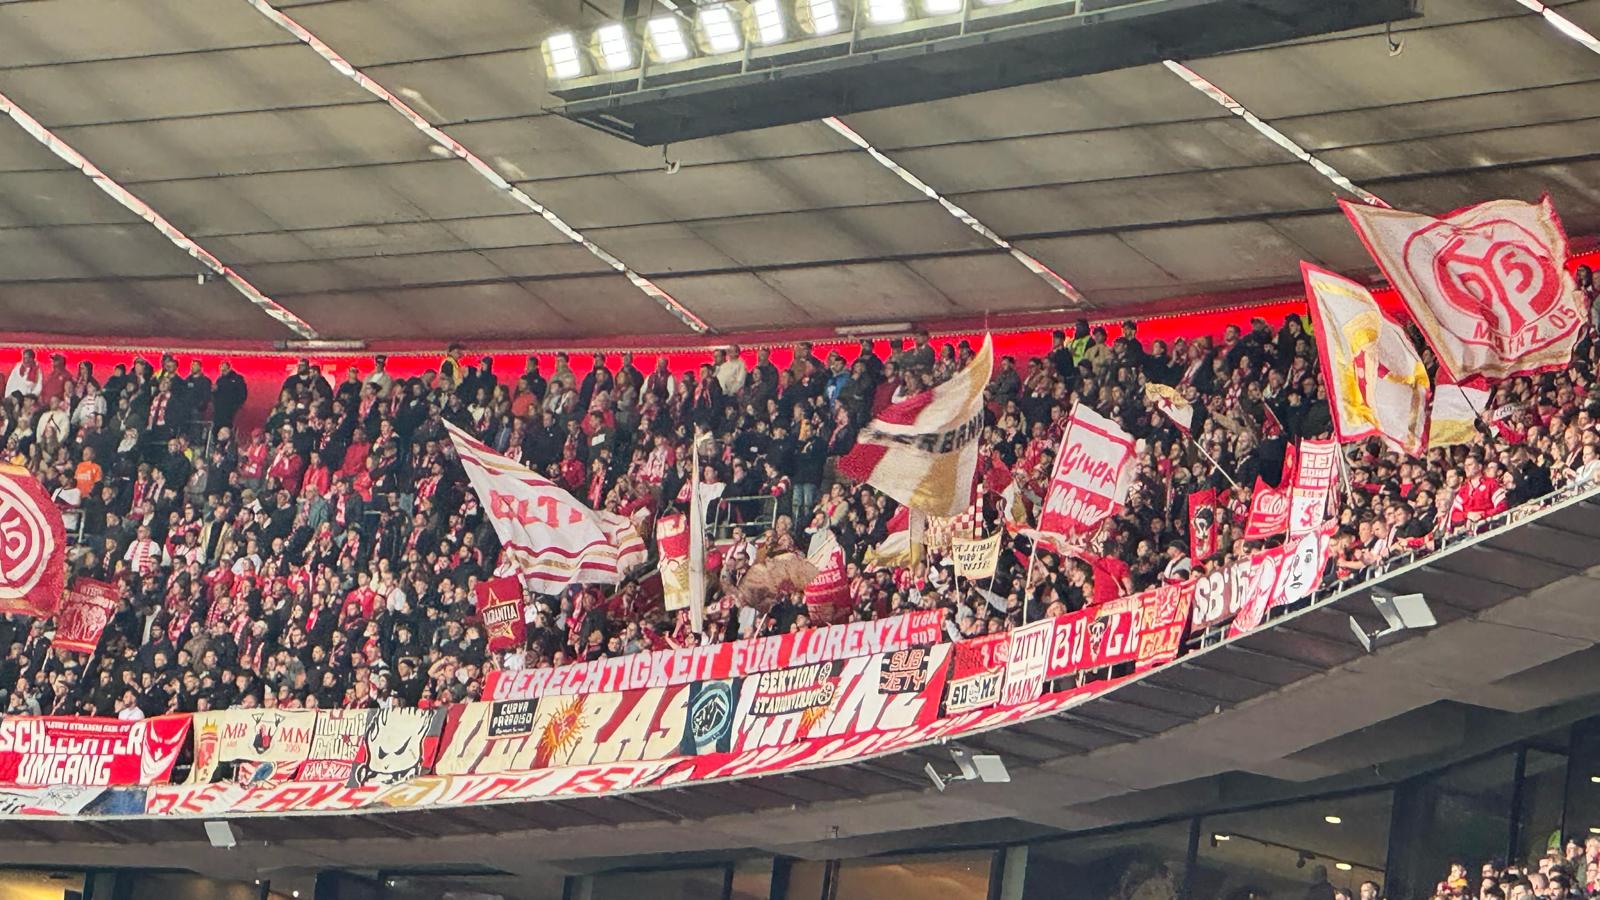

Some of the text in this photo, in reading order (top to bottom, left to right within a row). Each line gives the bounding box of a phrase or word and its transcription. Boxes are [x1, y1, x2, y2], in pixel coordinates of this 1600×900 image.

[492, 644, 721, 701] GERECHTIGKEIT
[729, 634, 783, 677] FÜR
[789, 613, 909, 668] LORENZ!
[889, 648, 925, 672] SUB
[1013, 628, 1048, 663] ZITTY
[759, 665, 819, 694] SEKTION
[1006, 674, 1042, 706] MAINZ
[492, 713, 533, 728] PARADISO
[500, 701, 529, 716] CURVA
[223, 722, 310, 744] MB MM
[15, 753, 114, 786] UMGANG
